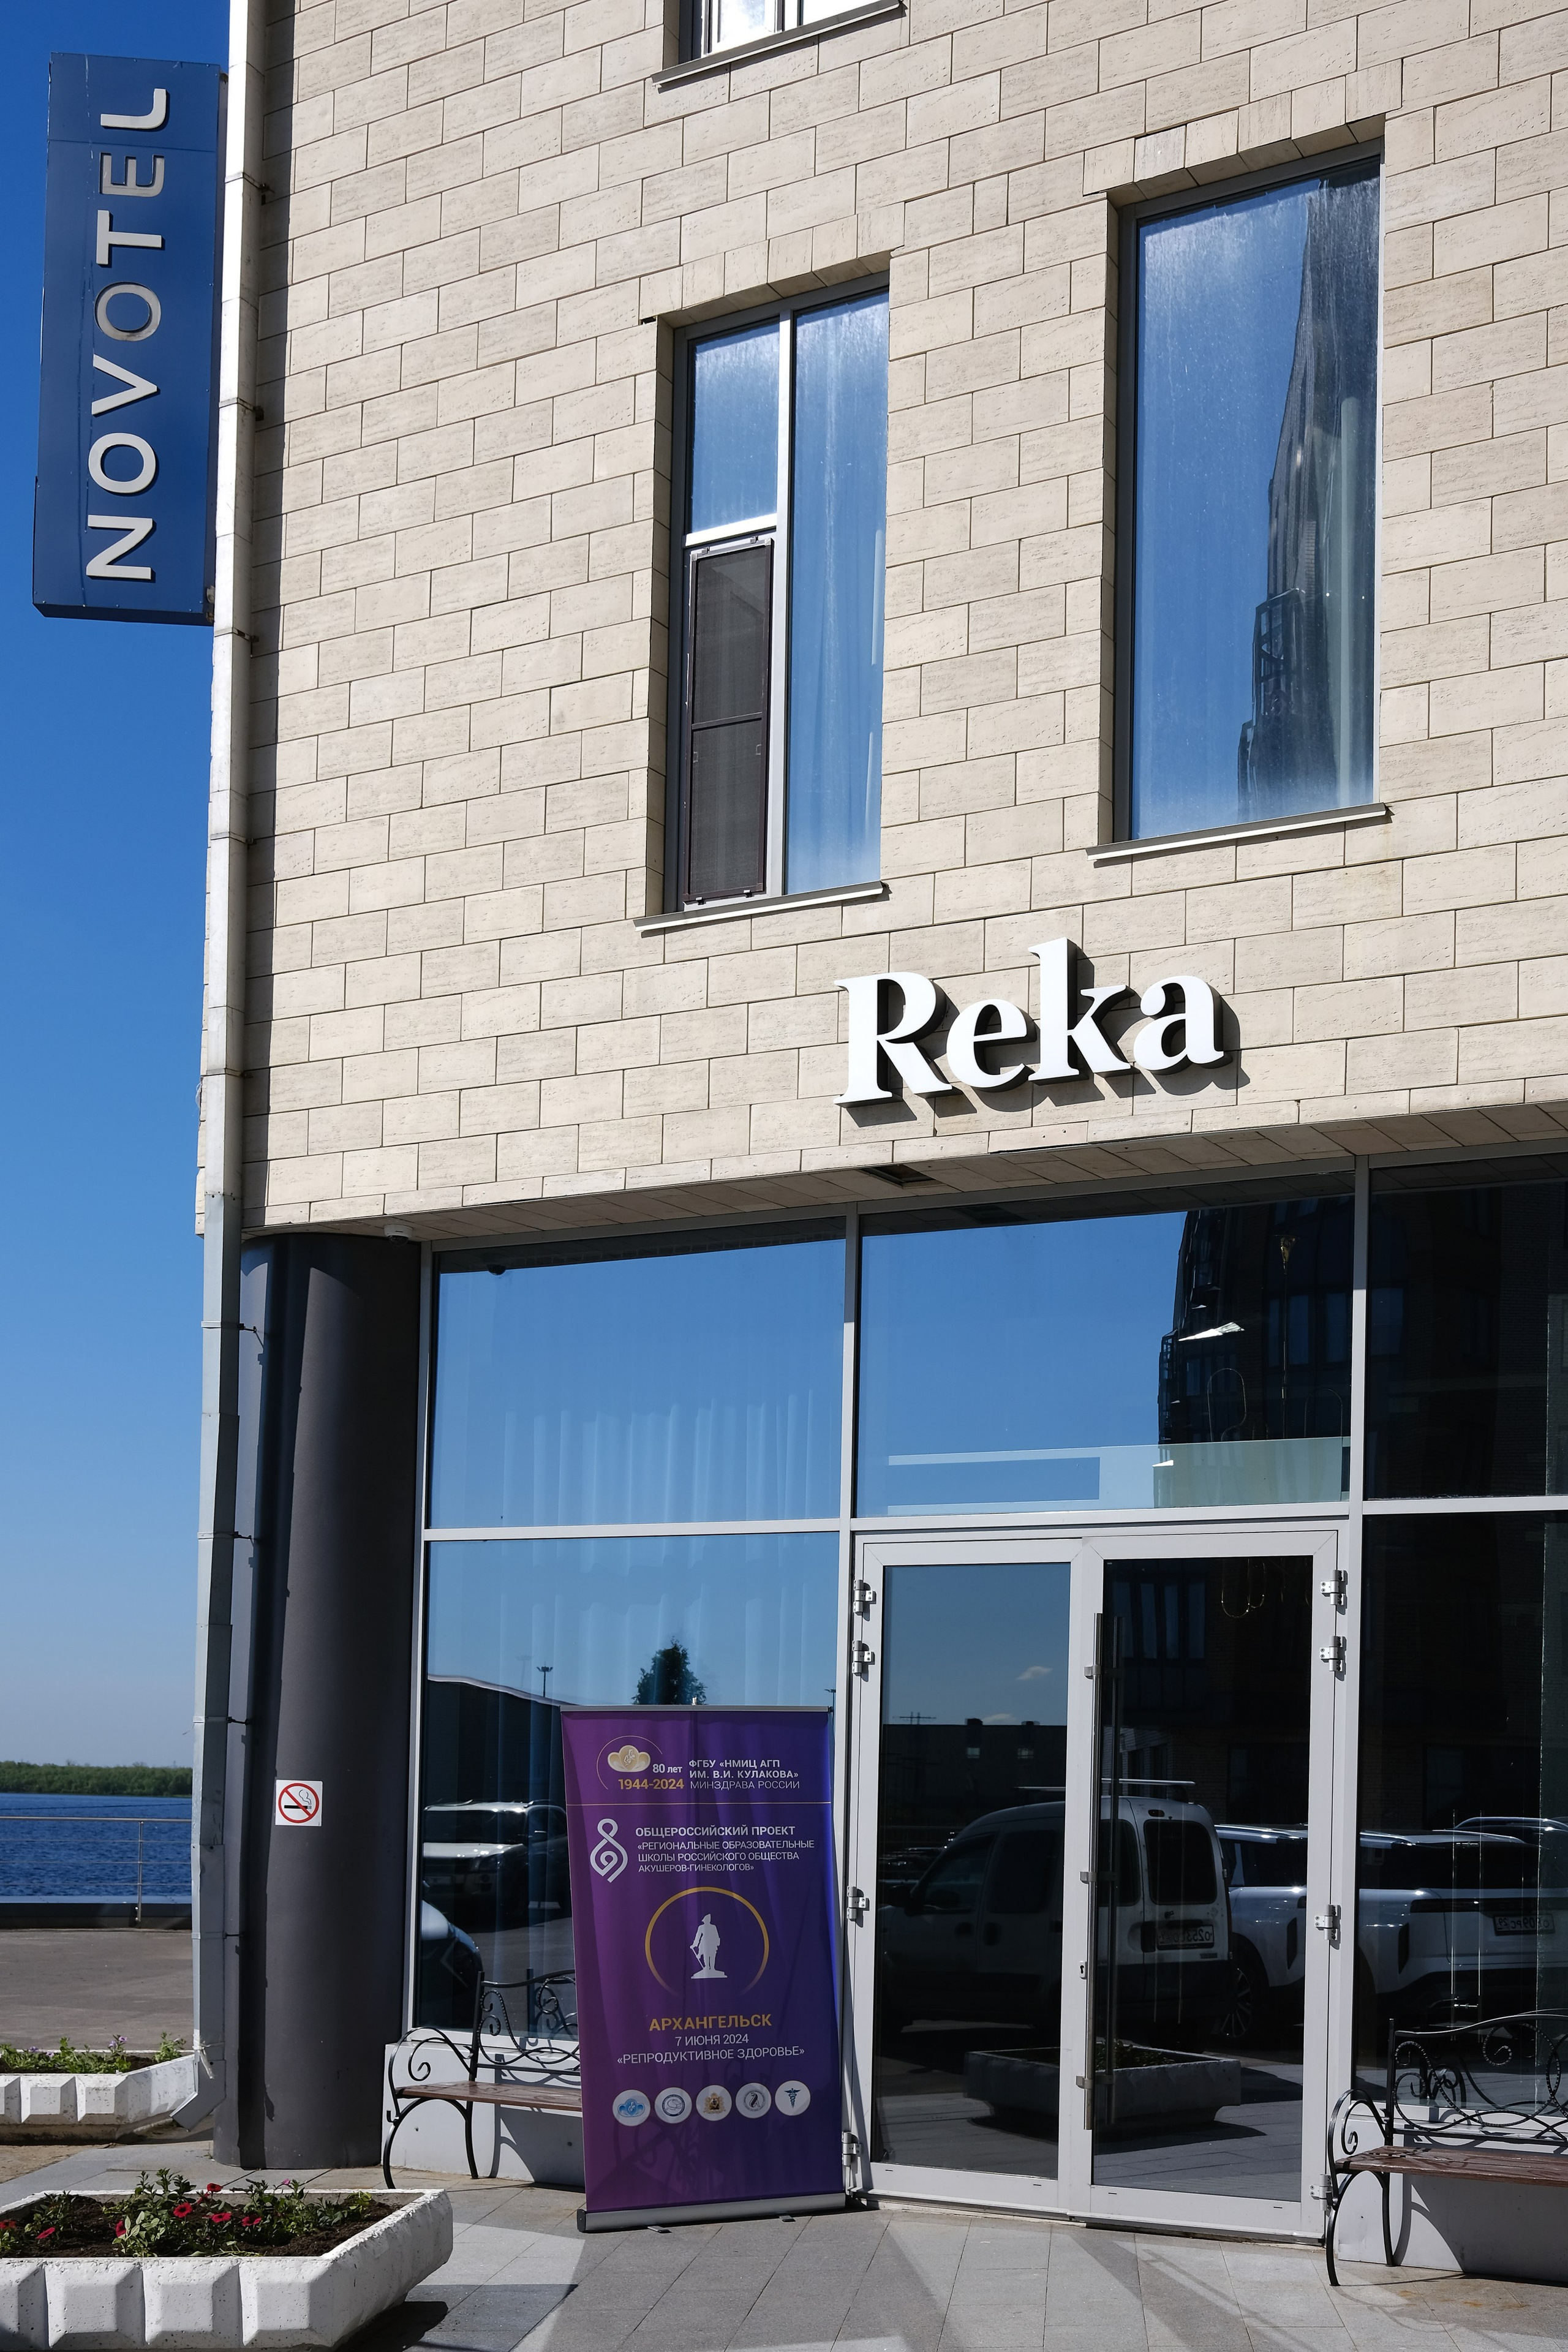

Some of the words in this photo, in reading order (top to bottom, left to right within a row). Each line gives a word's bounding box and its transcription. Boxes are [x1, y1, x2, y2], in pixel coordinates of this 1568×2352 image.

[86, 87, 168, 579] NOVOTEL
[834, 937, 1224, 1105] Reka
[652, 1763, 666, 1773] 80
[667, 1765, 682, 1773] лет
[688, 1759, 716, 1769] ФГБУ
[720, 1759, 758, 1769] «НМИЦ
[760, 1758, 780, 1768] АГП
[689, 1770, 710, 1779] ИМ.
[737, 1769, 799, 1779] КУЛАКОВА»
[618, 1778, 685, 1790] 1944-2024
[690, 1781, 755, 1790] МИНЗДРАВА
[758, 1780, 801, 1789] РОССИИ
[635, 1824, 748, 1838] ОБЩЕРОССИЙСКИЙ
[751, 1826, 796, 1836] ПРОЕКТ
[637, 1841, 720, 1850] «РЕГИОНАЛЬНЫЕ
[722, 1839, 815, 1849] ОБРАЗОВАТЕЛЬНЫЕ
[638, 1853, 676, 1862] ШКОЛЫ
[677, 1850, 746, 1861] РОССИЙСКОГО
[748, 1851, 799, 1861] ОБЩЕСТВА
[638, 1863, 755, 1872] АКУШЕРОВ-ГИНЕКОЛОГОВ»
[649, 2014, 772, 2031] АРХАНГЕЛЬСК
[674, 2036, 682, 2046] 7
[685, 2034, 721, 2046] ИЮНЯ
[723, 2033, 749, 2045] 2024
[617, 2049, 734, 2065] «РЕПРОДУКТИВНОЕ
[737, 2046, 805, 2060] ЗДОРОВЬЕ»
